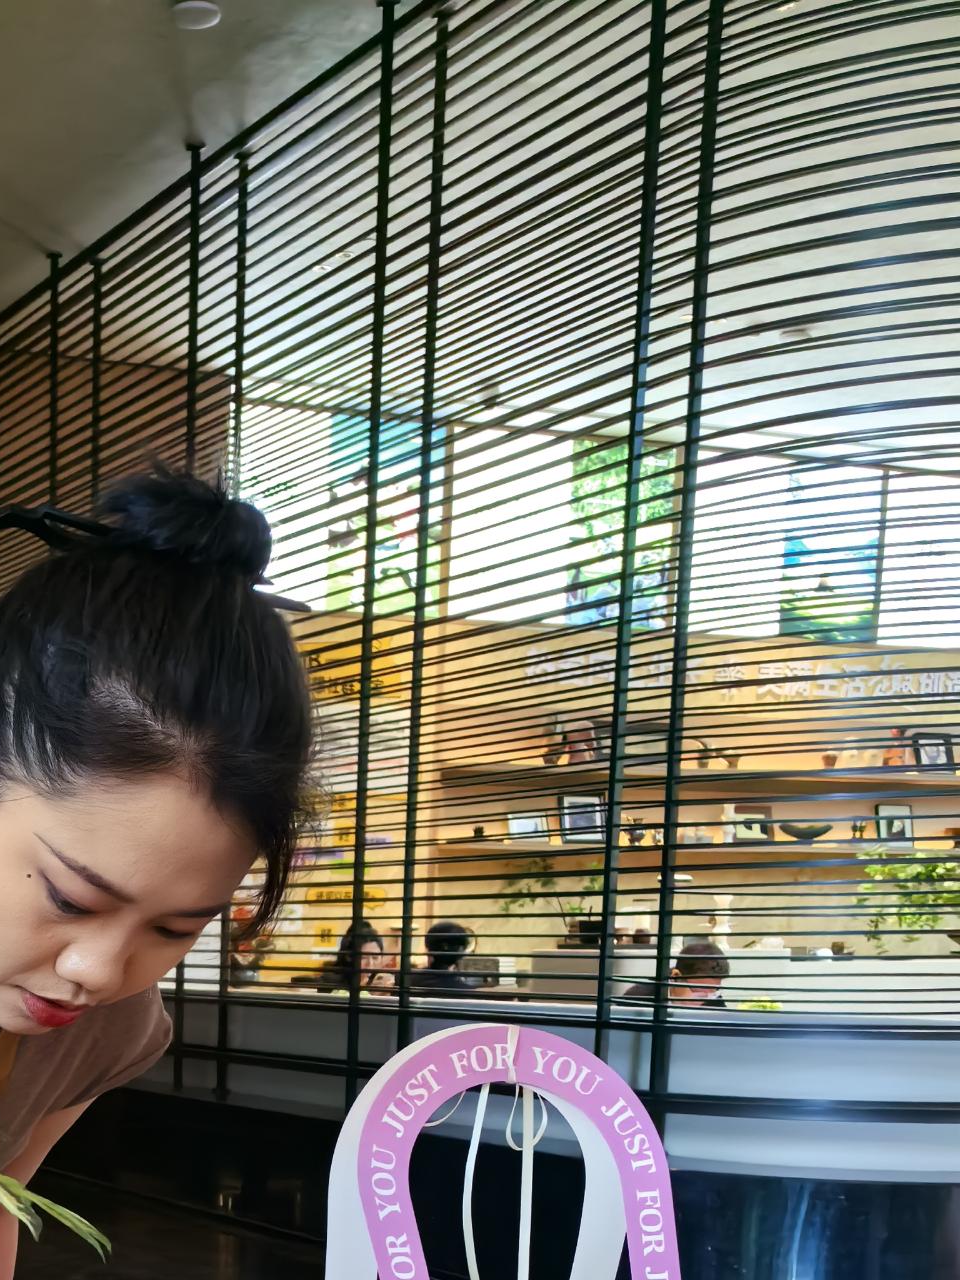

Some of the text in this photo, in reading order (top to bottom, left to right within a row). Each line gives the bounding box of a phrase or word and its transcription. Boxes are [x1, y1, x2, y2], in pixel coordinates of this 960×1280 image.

[381, 1063, 442, 1138] JUST
[531, 1046, 604, 1095] YOU
[600, 1097, 656, 1175] JUST
[371, 1143, 401, 1221] YOU
[635, 1188, 666, 1258] FOR
